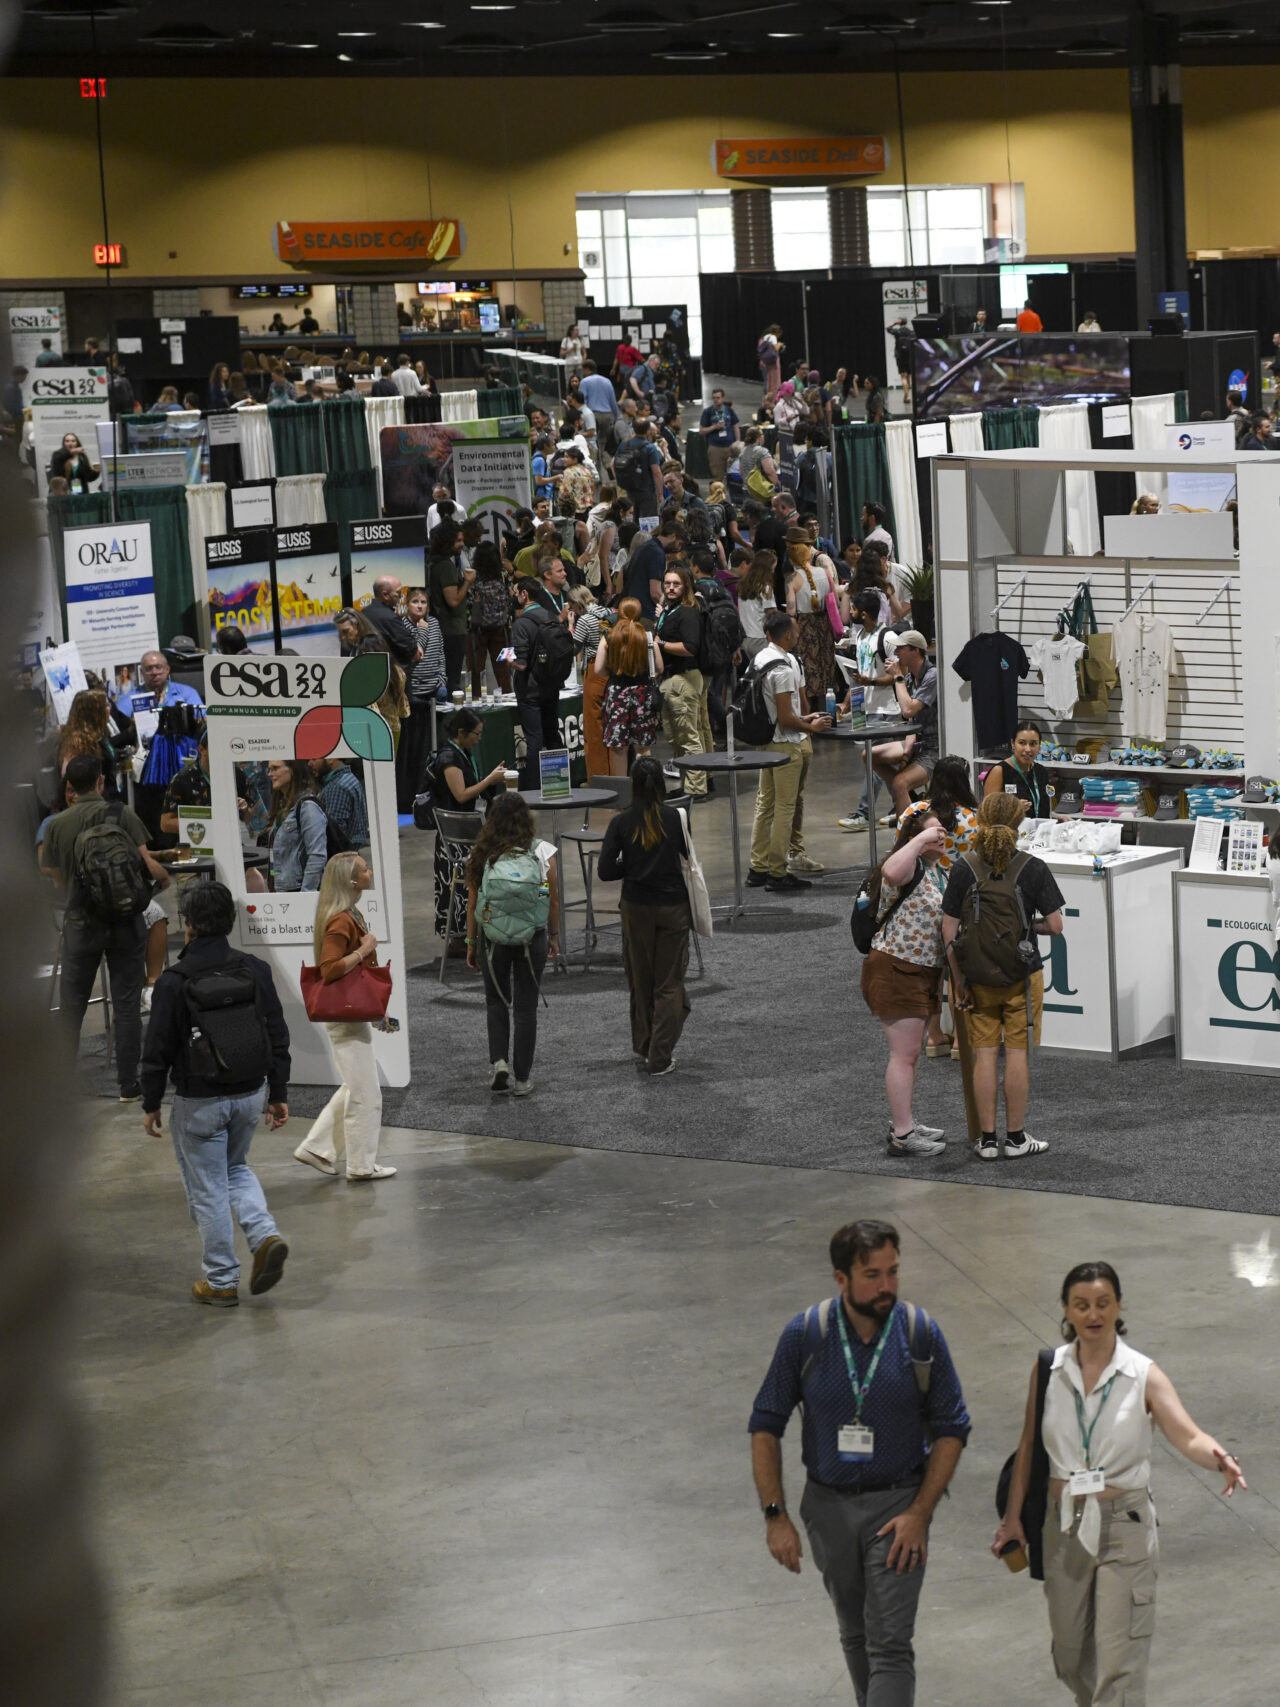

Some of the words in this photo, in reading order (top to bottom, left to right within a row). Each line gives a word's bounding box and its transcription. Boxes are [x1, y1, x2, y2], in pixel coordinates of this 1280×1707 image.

[80, 78, 106, 98] EXIT
[746, 149, 820, 164] SEASIDE
[826, 148, 860, 164] Deli
[304, 232, 384, 248] SEASIDE
[11, 315, 38, 328] esa
[32, 378, 76, 396] esa
[459, 449, 524, 460] Environmental
[460, 464, 482, 472] Data
[484, 462, 525, 472] Initiative
[286, 530, 311, 548] USGS
[364, 524, 392, 540] USGS
[78, 537, 138, 566] ORAU
[217, 540, 242, 556] USGS
[210, 662, 294, 698] esa
[296, 663, 326, 682] 20
[296, 680, 326, 698] 24
[248, 924, 268, 935] Had
[280, 924, 302, 934] blast
[305, 925, 314, 933] at
[1224, 920, 1273, 932] ECOLOGICAL
